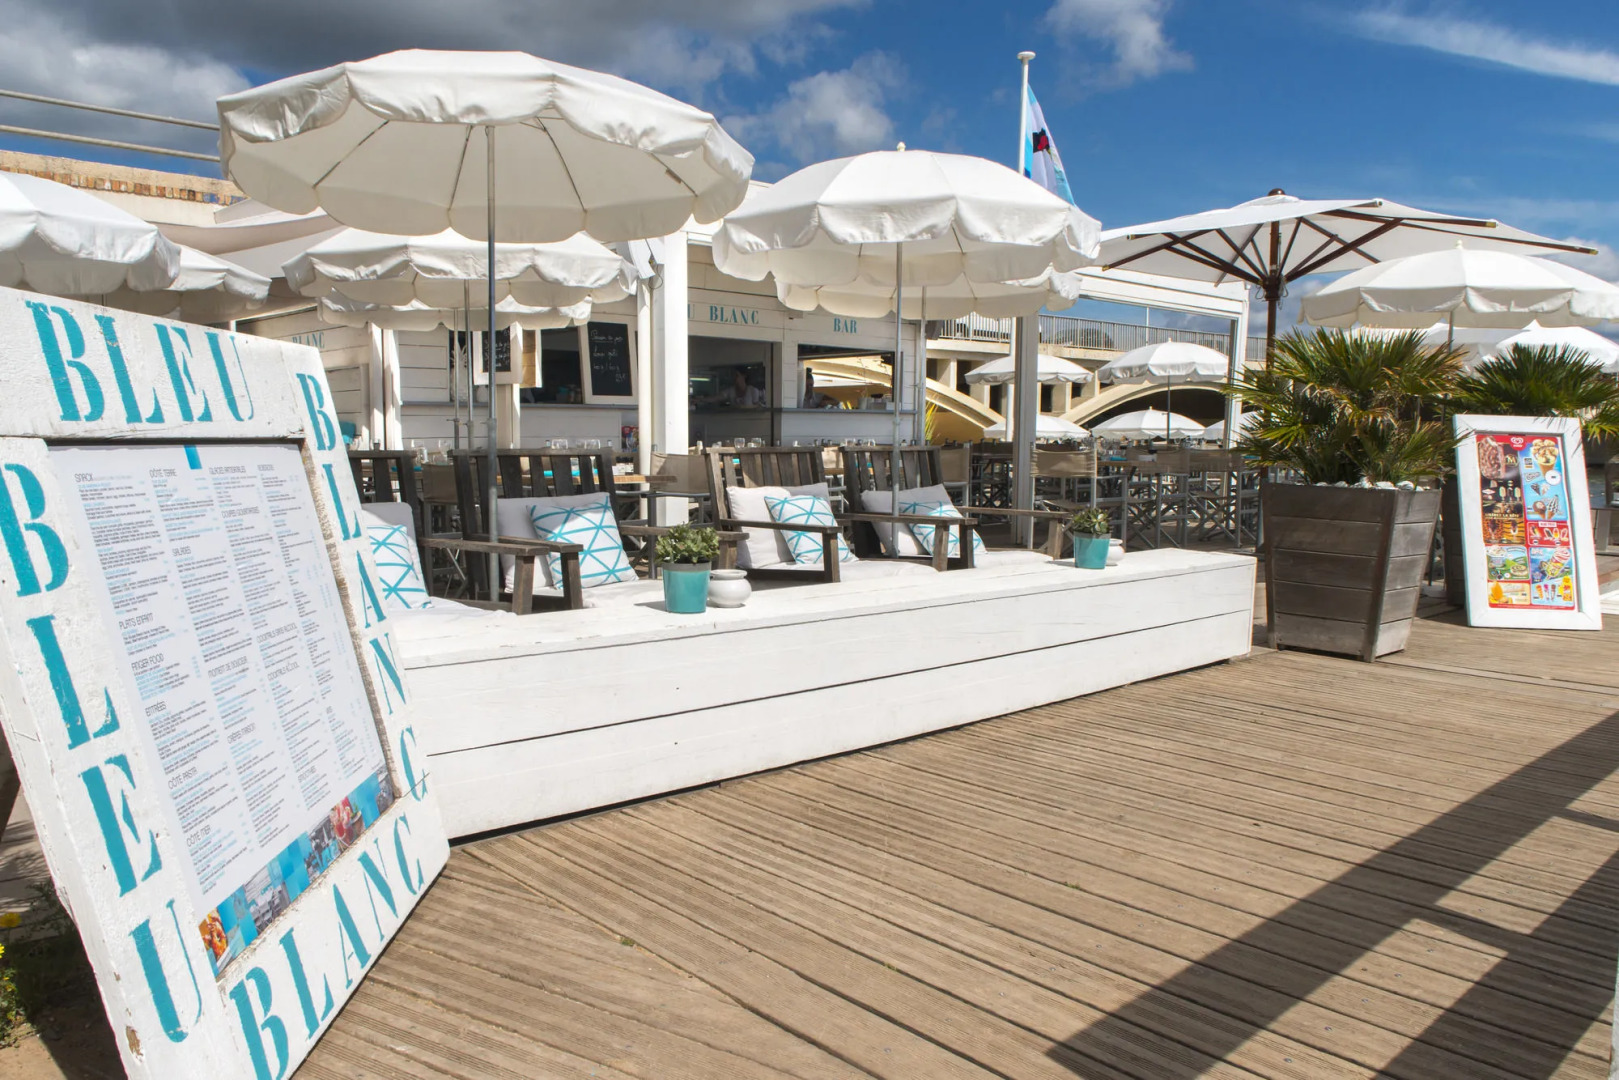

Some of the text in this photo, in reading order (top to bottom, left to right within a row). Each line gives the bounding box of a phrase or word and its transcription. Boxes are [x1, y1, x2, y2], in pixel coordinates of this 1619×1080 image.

[25, 300, 254, 424] BLEU
[709, 305, 760, 325] BLANC
[833, 317, 857, 334] BAR
[296, 373, 431, 801] BLANC
[149, 653, 164, 667] FOOD
[0, 463, 203, 1043] BLEU
[229, 812, 425, 1080] BLANC
